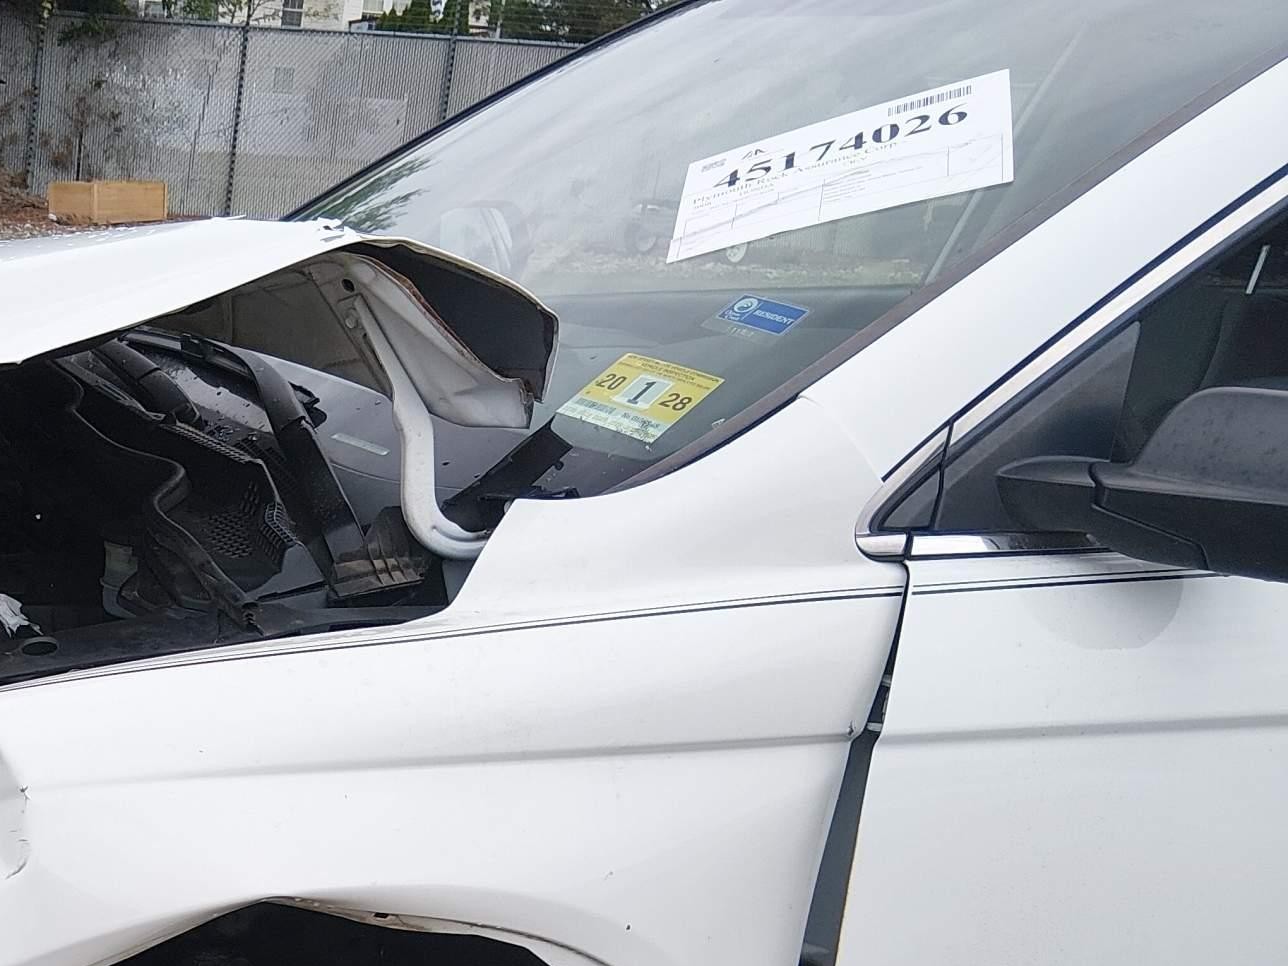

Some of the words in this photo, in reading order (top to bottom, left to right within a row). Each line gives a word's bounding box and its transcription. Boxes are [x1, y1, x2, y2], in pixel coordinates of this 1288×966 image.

[712, 102, 968, 188] 45174026
[753, 309, 795, 325] RESIDENT
[596, 373, 627, 390] 20
[627, 381, 656, 404] 1
[658, 392, 692, 411] 28
